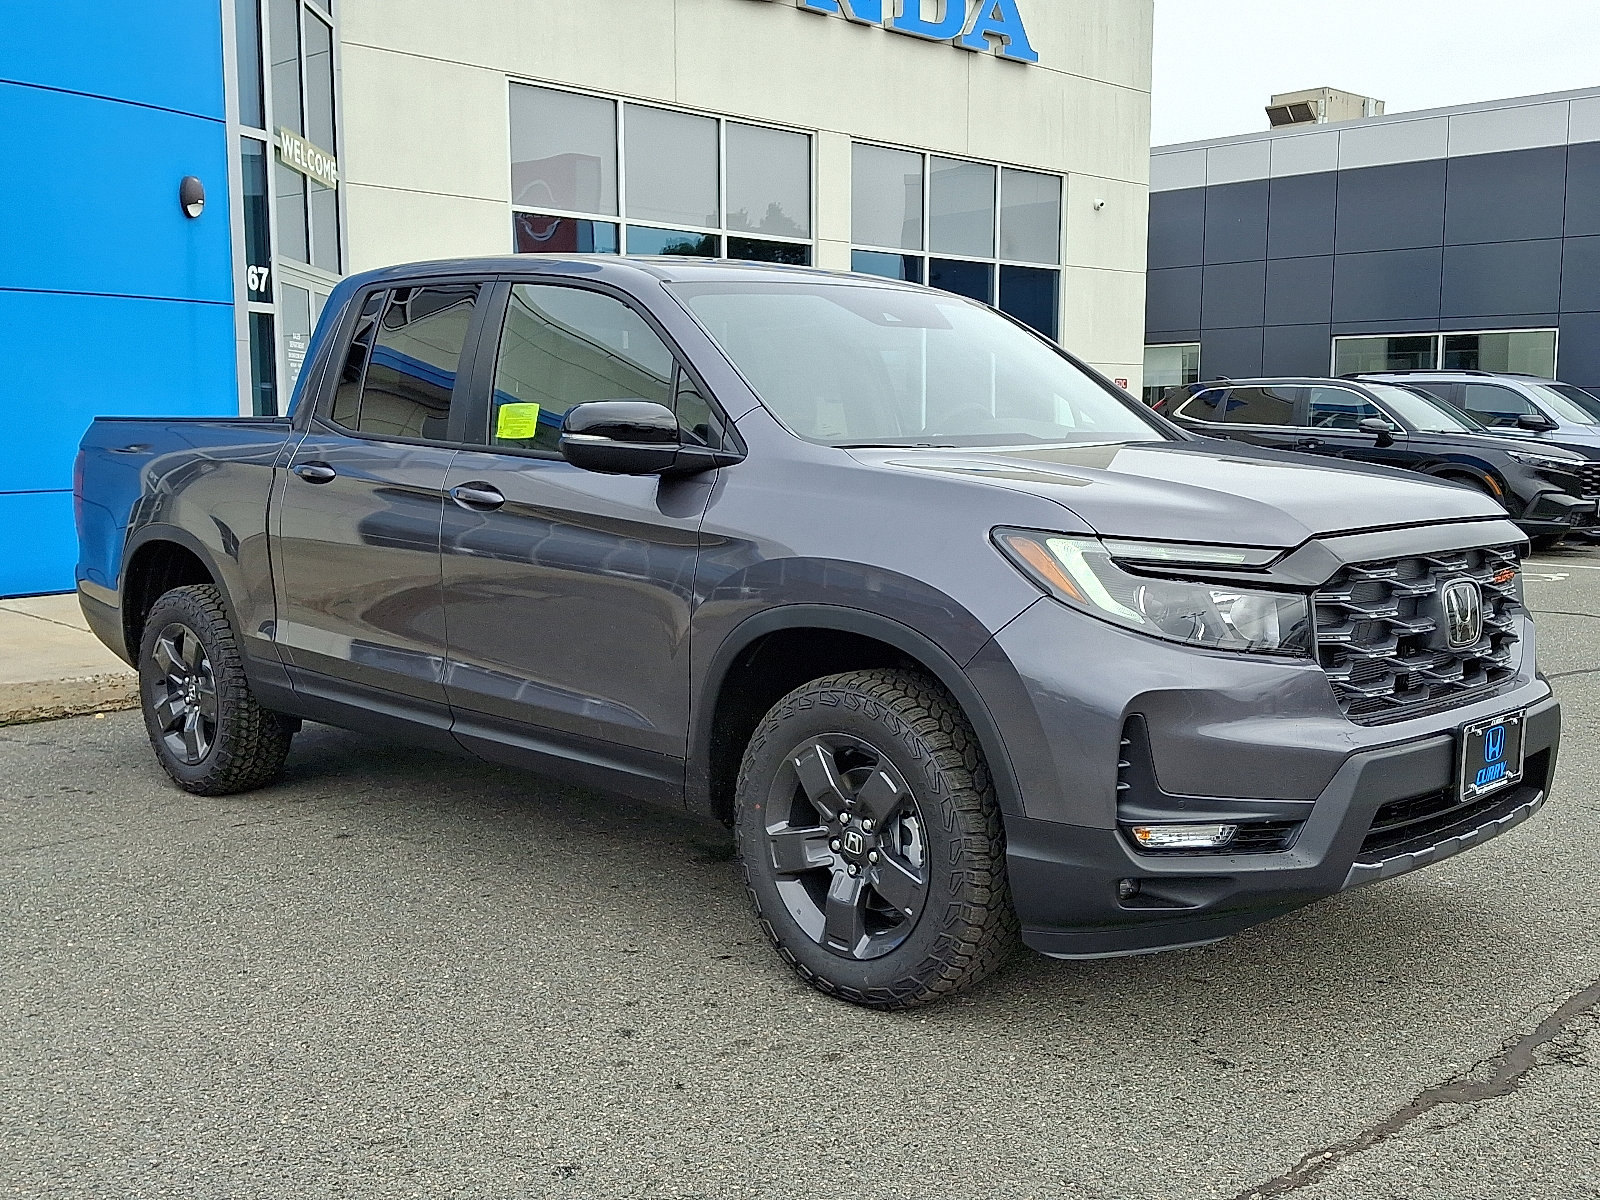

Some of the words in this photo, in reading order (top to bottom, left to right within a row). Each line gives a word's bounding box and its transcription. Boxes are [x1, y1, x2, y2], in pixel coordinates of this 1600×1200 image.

[280, 131, 336, 185] WELCOME
[248, 265, 269, 292] 67
[1476, 760, 1508, 786] CURRY
